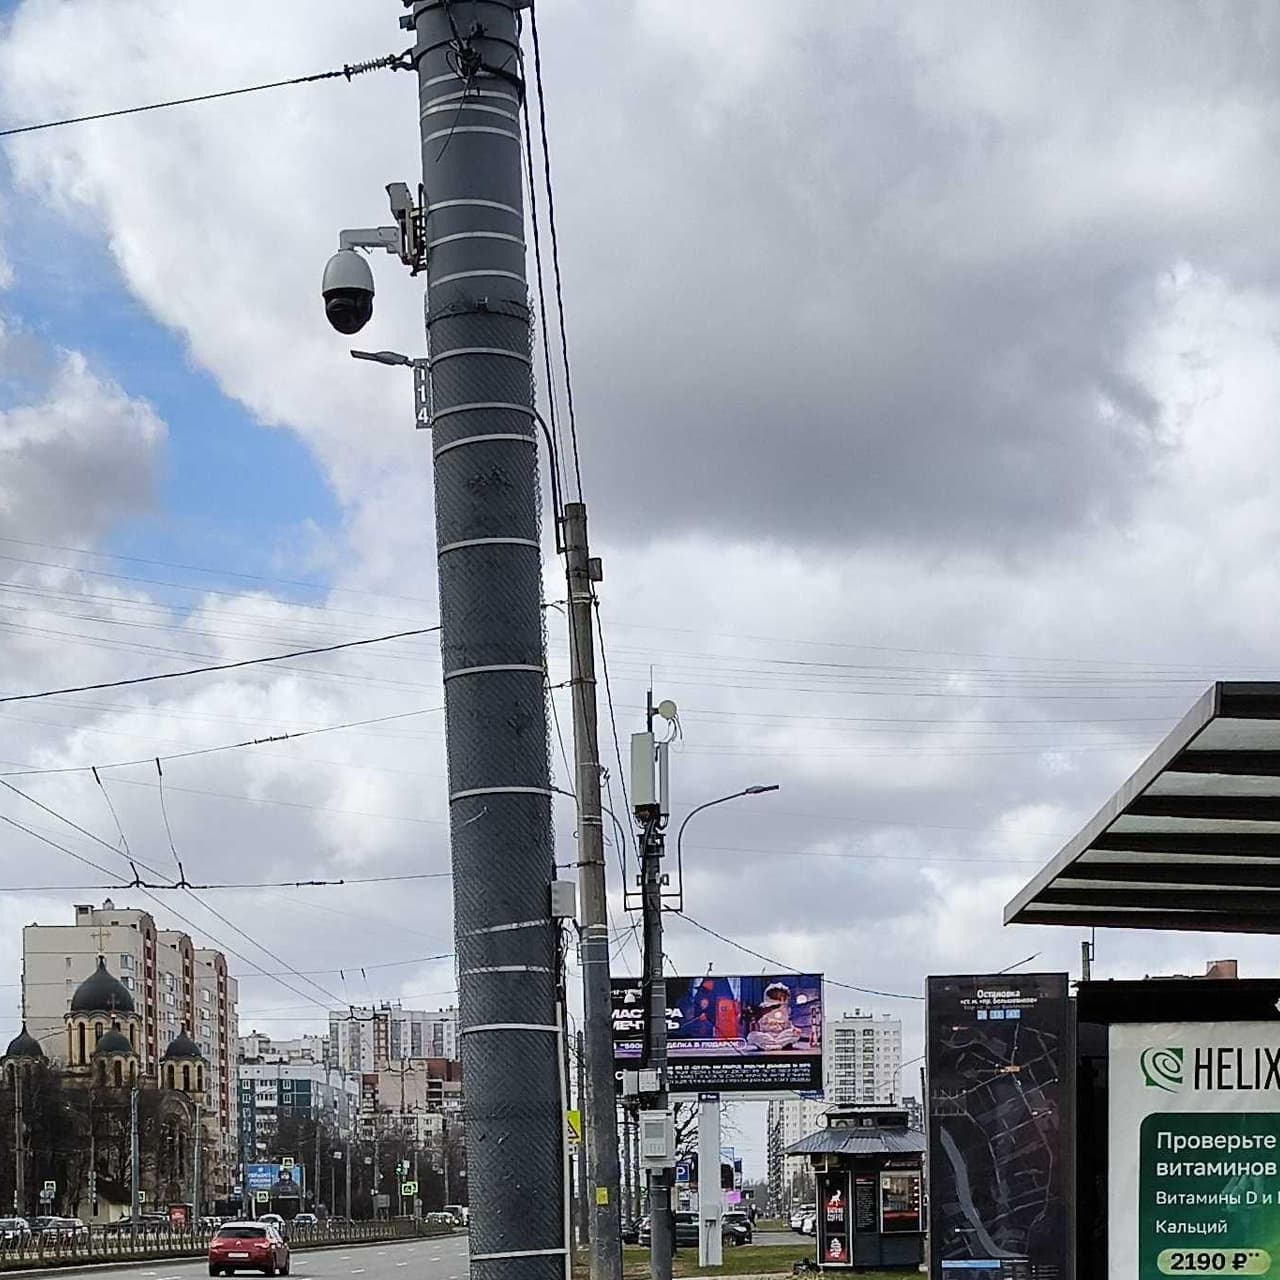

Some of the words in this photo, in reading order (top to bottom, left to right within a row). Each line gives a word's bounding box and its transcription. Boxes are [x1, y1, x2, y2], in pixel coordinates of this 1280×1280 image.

[1157, 1132, 1277, 1153] Проверьте
[1157, 1160, 1277, 1177] витаминов
[1156, 1190, 1241, 1205] Витамины
[1246, 1191, 1258, 1204] D
[1263, 1193, 1272, 1204] и
[1156, 1219, 1228, 1236] Кальций
[1171, 1253, 1226, 1270] 2190
